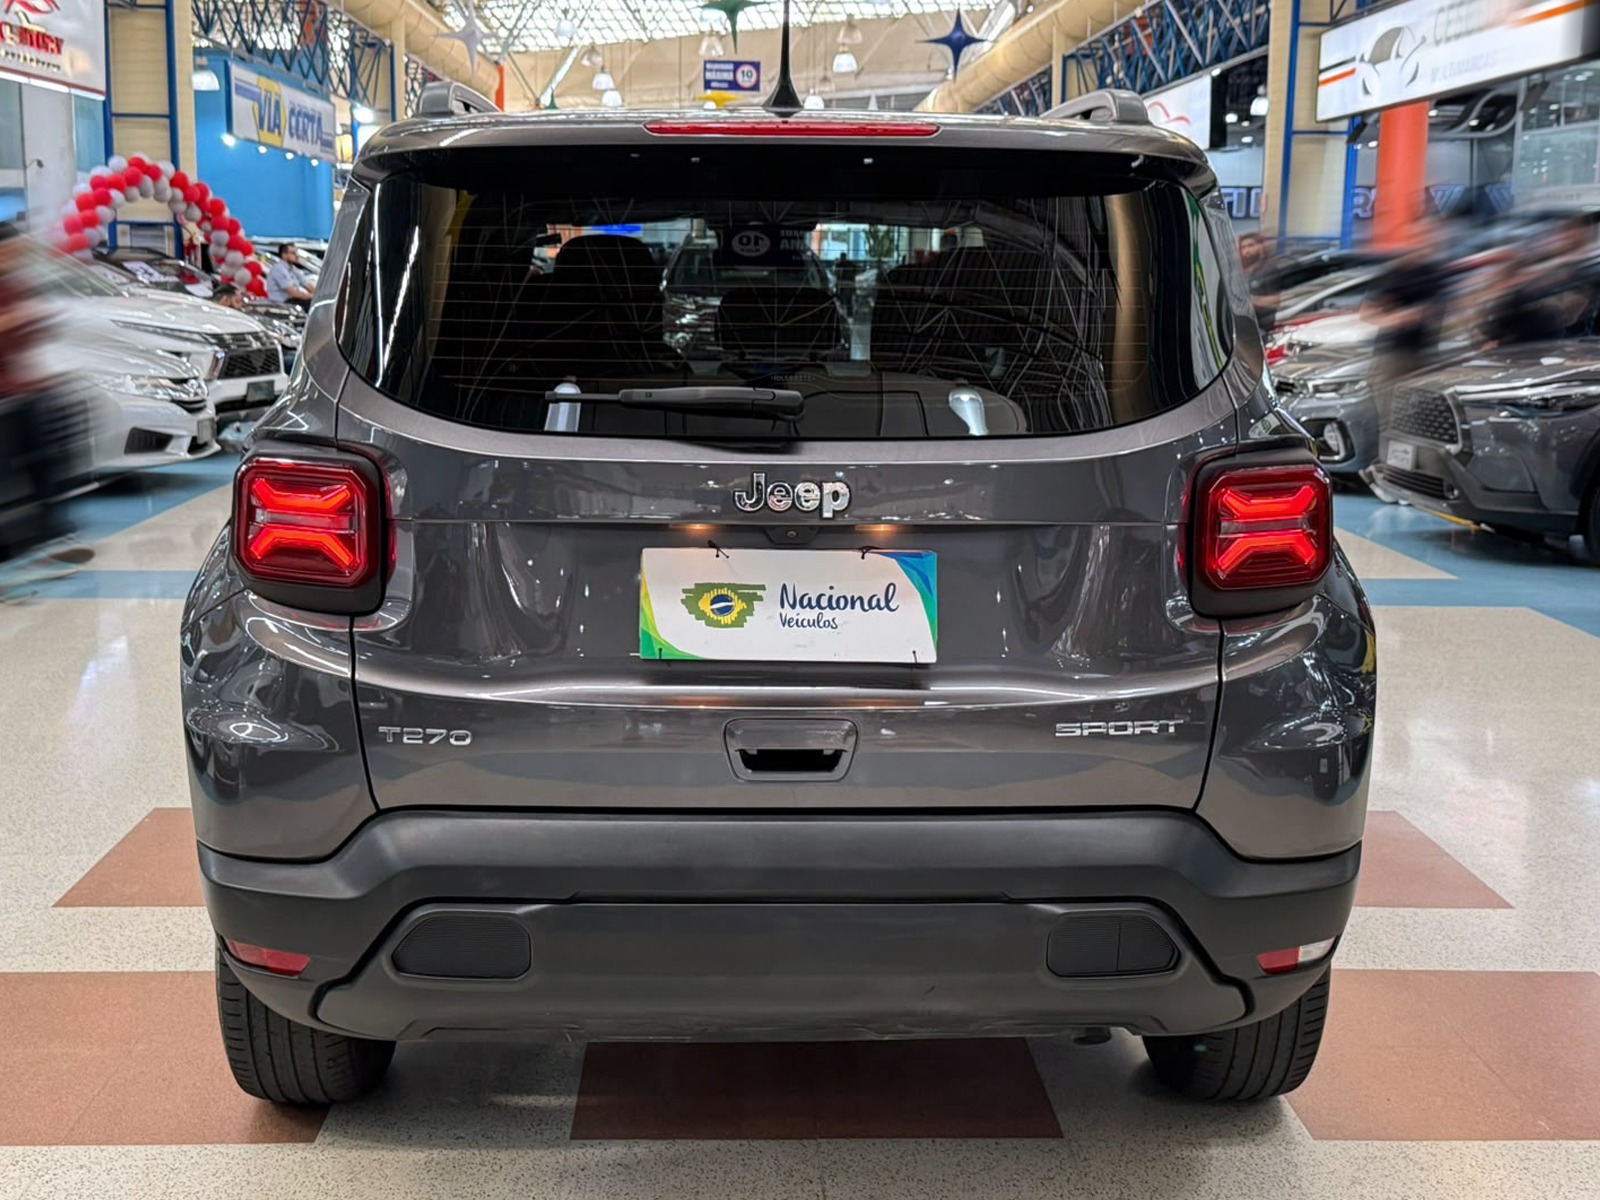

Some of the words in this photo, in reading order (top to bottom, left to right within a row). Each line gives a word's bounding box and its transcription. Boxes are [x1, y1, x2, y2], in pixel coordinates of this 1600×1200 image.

[741, 69, 753, 79] 10
[257, 88, 282, 137] VIA
[735, 472, 851, 518] Jeep
[779, 582, 900, 613] Nacional
[779, 612, 839, 630] Veículos
[378, 726, 472, 746] T270
[1055, 719, 1184, 736] SPORT
